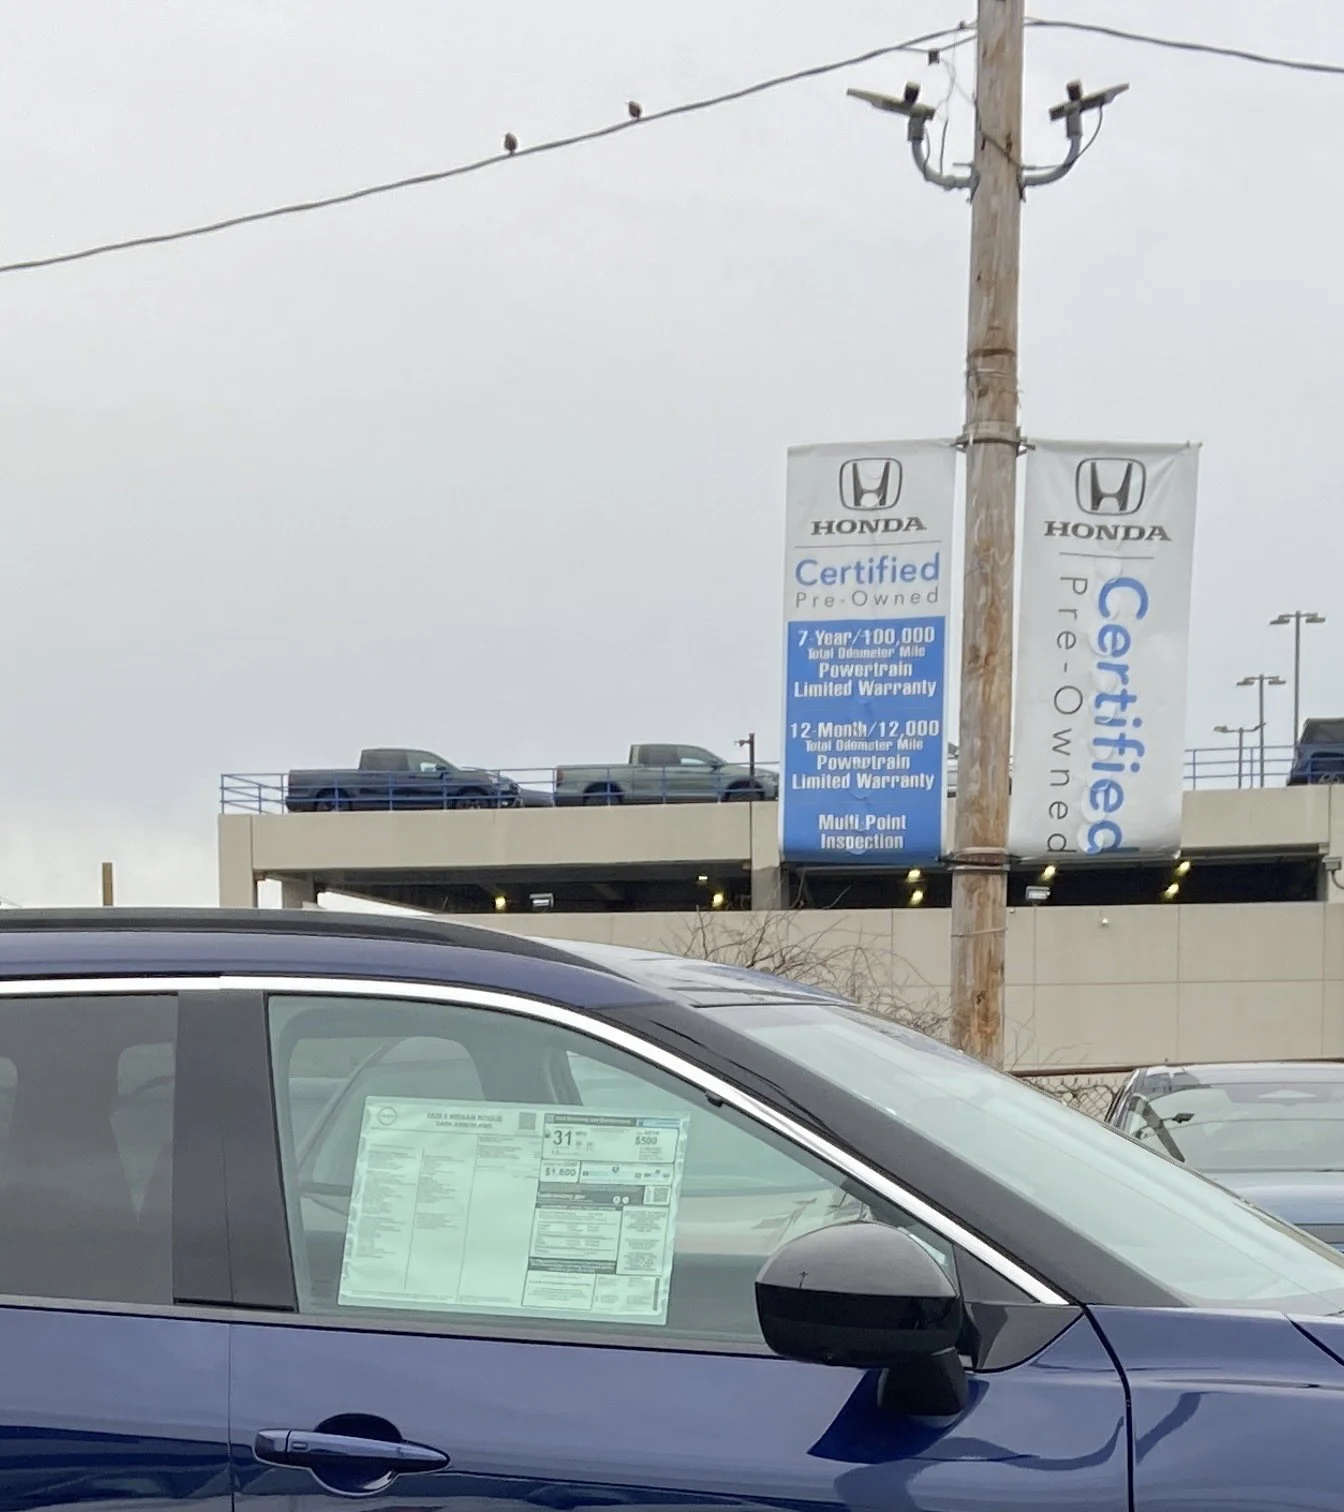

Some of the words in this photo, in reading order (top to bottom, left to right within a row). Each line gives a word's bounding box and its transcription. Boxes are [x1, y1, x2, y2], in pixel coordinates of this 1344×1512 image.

[811, 517, 927, 535] HONDA
[1044, 521, 1172, 541] HONDA
[795, 552, 940, 586] Certified
[796, 586, 939, 608] Pre-Owned
[808, 648, 834, 660] Total
[838, 647, 895, 659] Odometer
[899, 646, 926, 658] Mile
[819, 661, 913, 679] Powertrain
[794, 681, 853, 698] Limited
[858, 680, 937, 698] Warranty
[1047, 577, 1088, 854] Pre-Owned
[1087, 577, 1149, 857] Certified
[790, 719, 940, 739] 12-Month/12,000
[805, 740, 832, 753] Total
[836, 739, 893, 752] Odometer
[897, 738, 924, 751] Mile
[792, 773, 851, 790] Limited
[856, 773, 935, 790] Warranty
[821, 834, 904, 849] Inspection
[552, 1130, 573, 1146] 31
